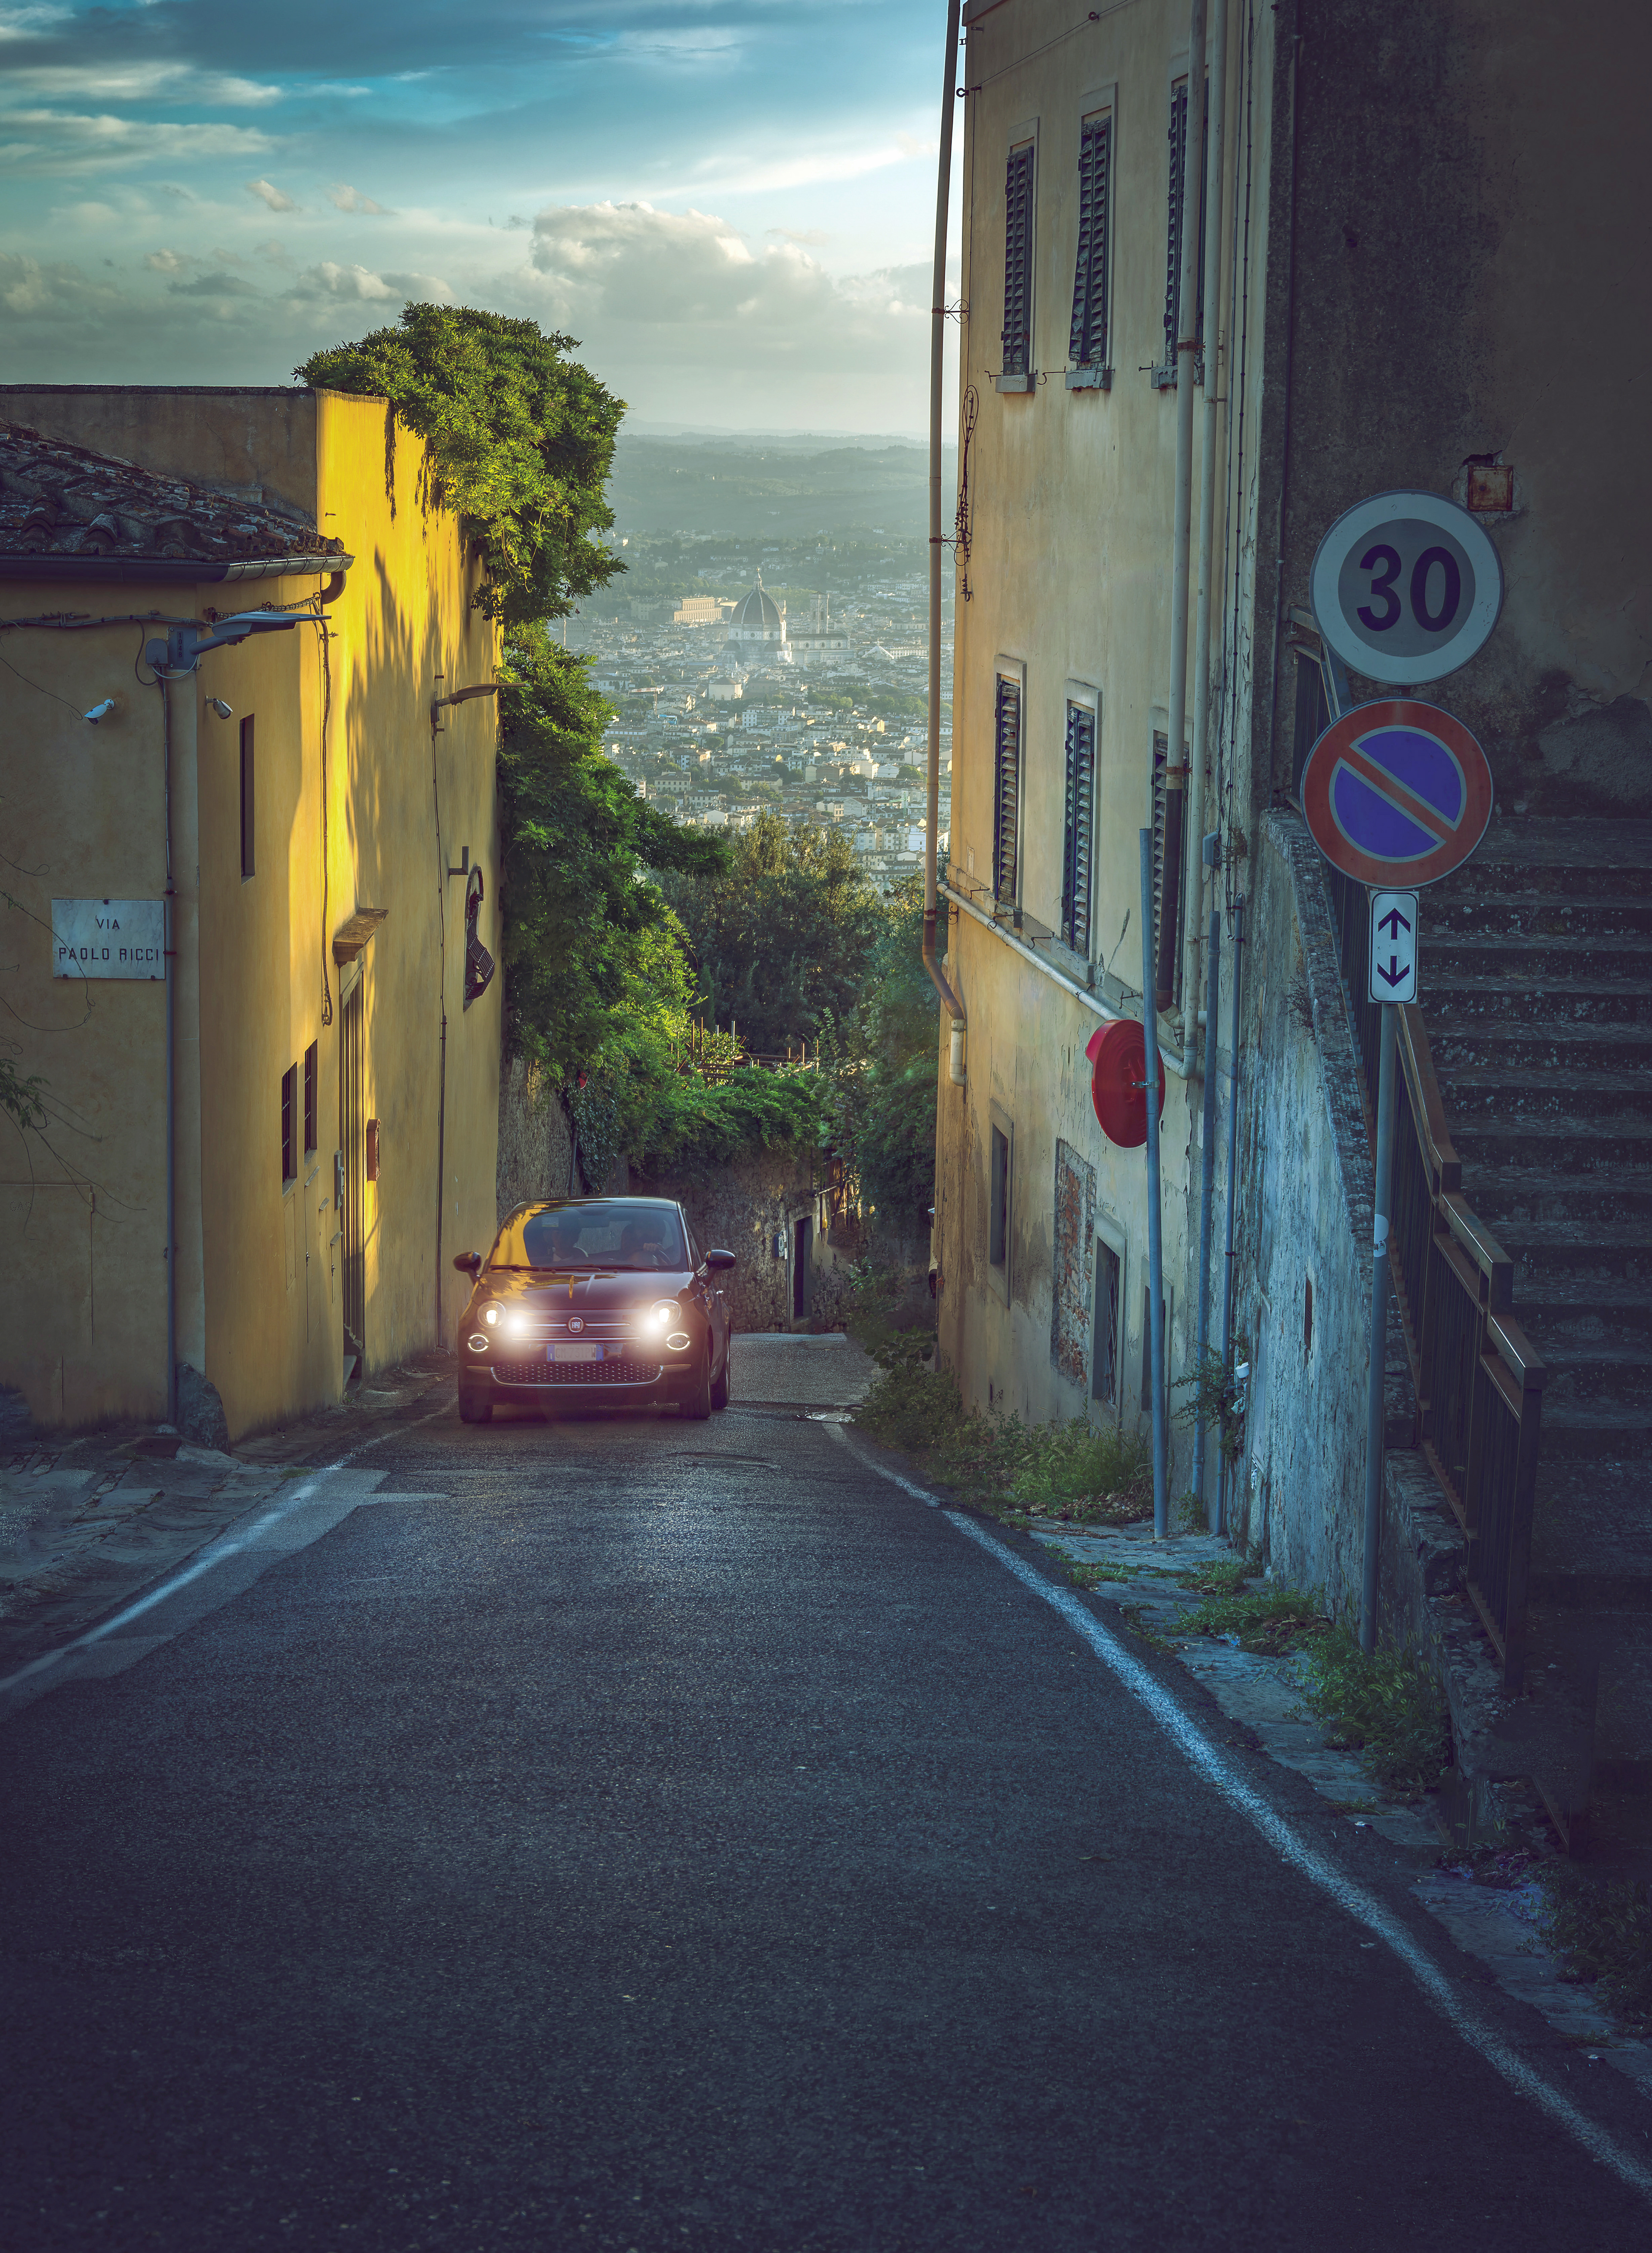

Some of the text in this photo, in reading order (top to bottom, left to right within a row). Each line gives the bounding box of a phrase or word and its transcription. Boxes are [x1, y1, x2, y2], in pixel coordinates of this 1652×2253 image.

[1356, 544, 1461, 633] 30
[96, 919, 120, 929] VIA
[59, 947, 159, 961] PAOLO RICCI
[9, 1201, 32, 1212] GAS
